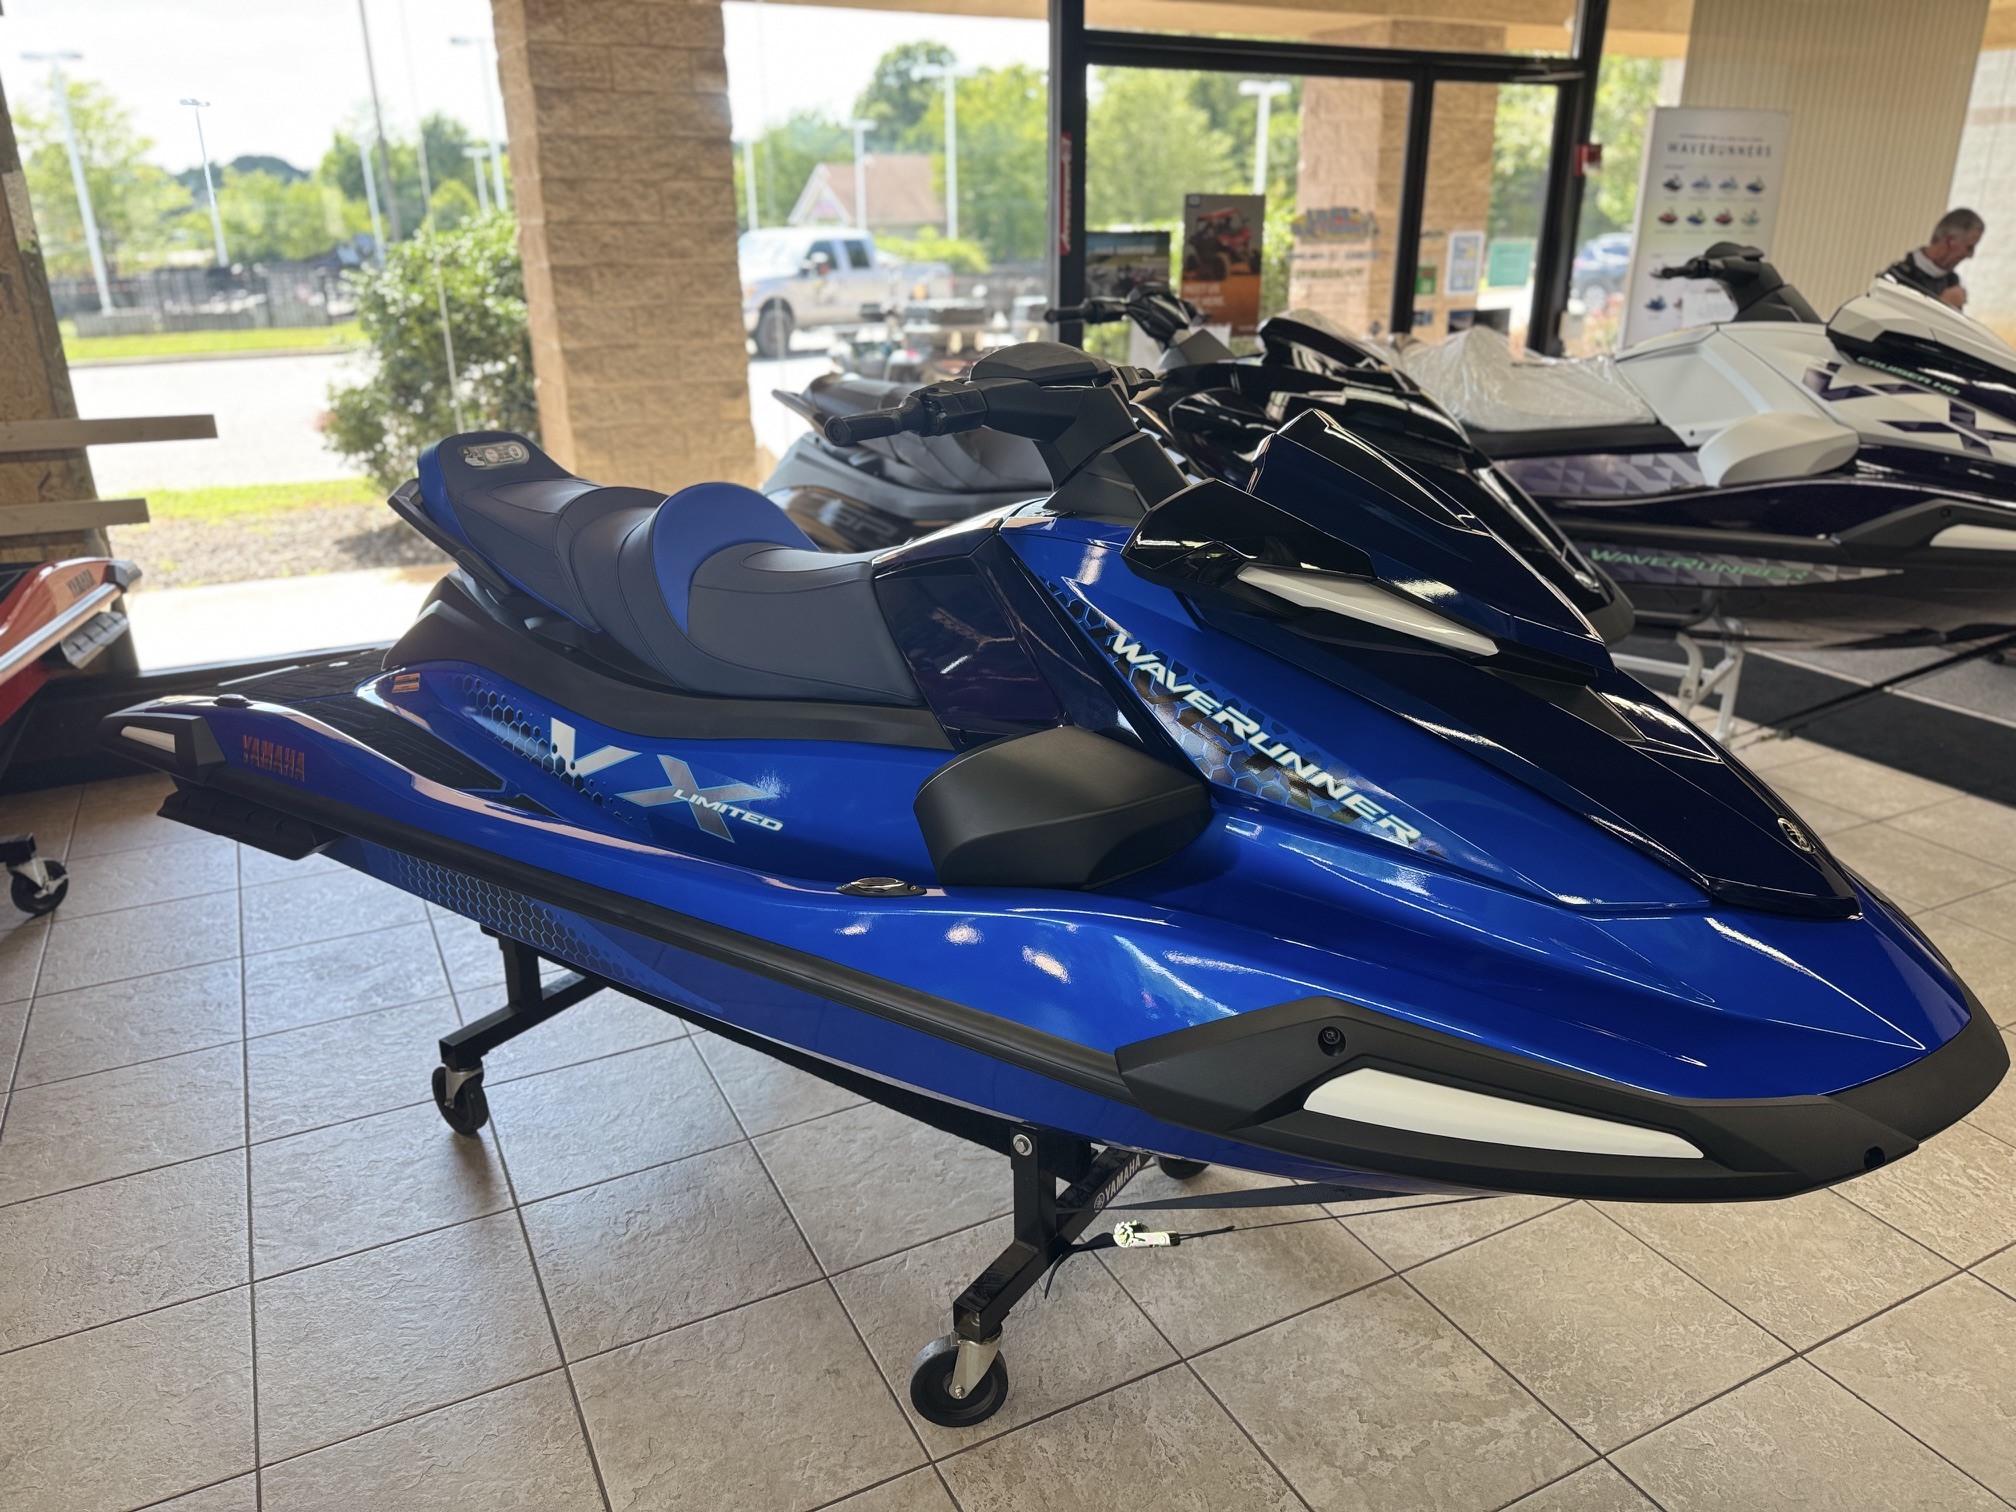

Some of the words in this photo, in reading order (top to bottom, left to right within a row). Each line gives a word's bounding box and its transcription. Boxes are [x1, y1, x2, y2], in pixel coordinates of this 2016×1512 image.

[1591, 549, 1808, 580] WAVERUNNER
[242, 734, 305, 782] YAMAHA
[1112, 631, 1422, 845] WAVERUNNER
[673, 788, 783, 832] LIMITED
[1105, 1153, 1141, 1202] YAMAHA
